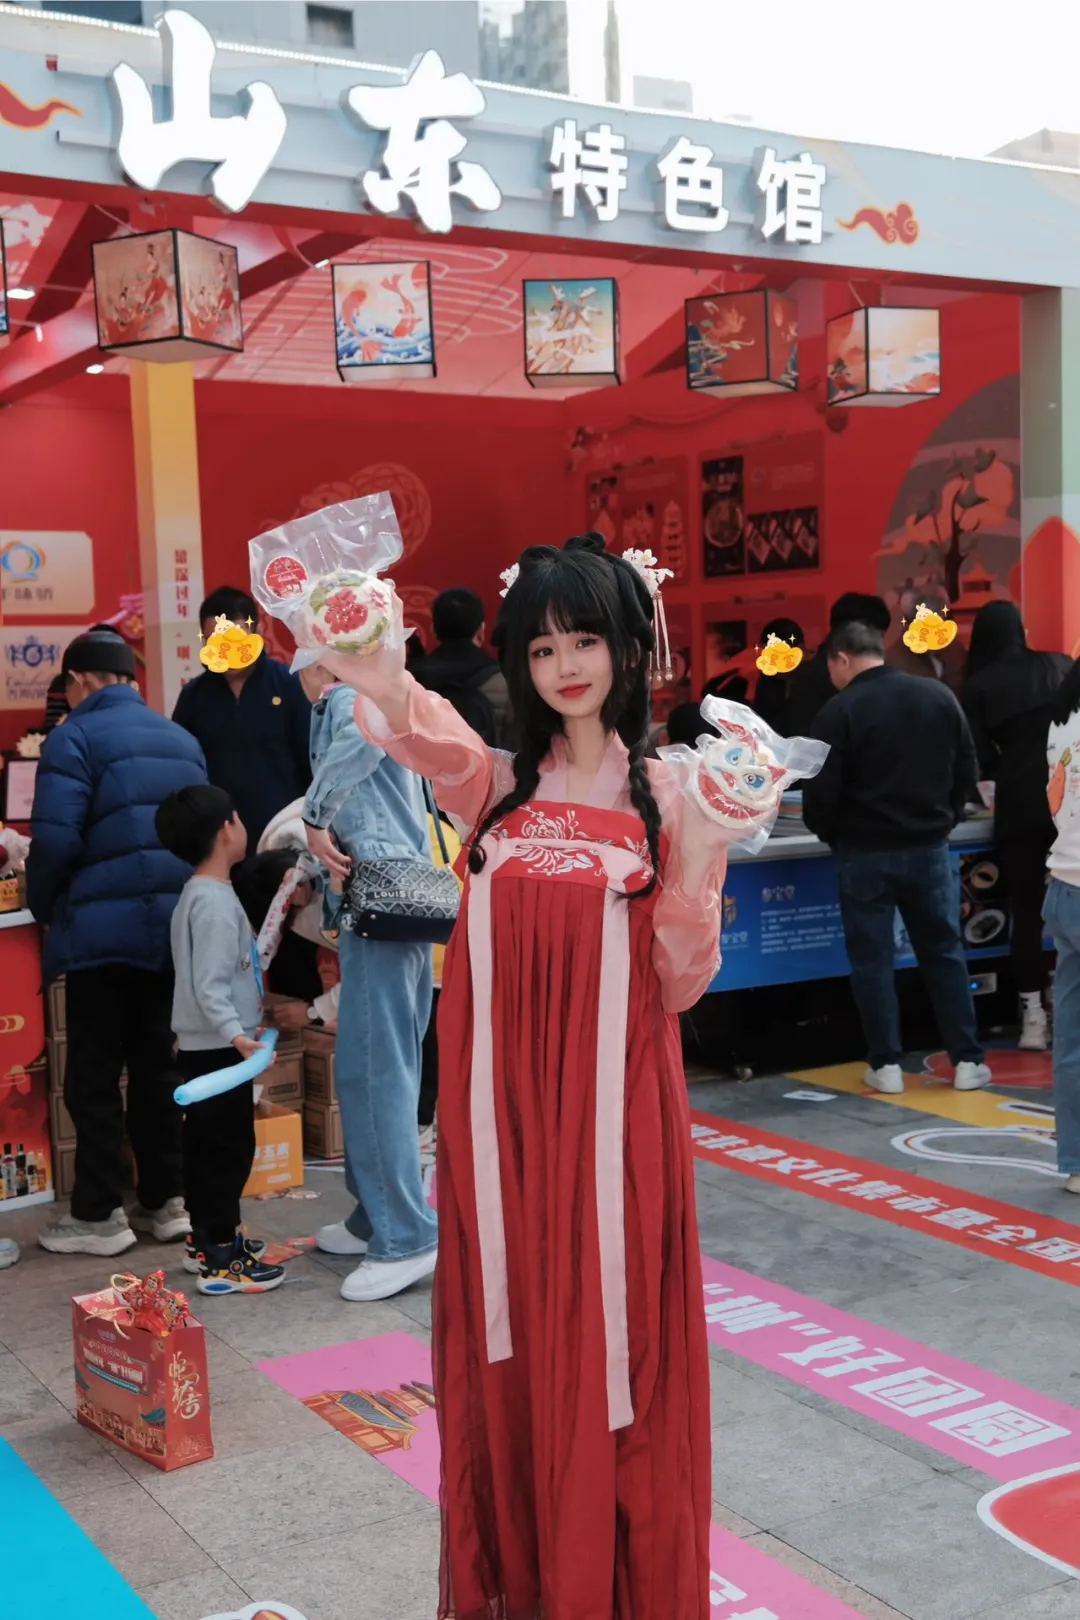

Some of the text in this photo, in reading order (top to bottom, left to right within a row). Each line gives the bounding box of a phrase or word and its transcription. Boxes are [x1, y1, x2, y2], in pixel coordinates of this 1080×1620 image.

[112, 10, 827, 244] 山东特色馆
[374, 890, 406, 899] LOUIS
